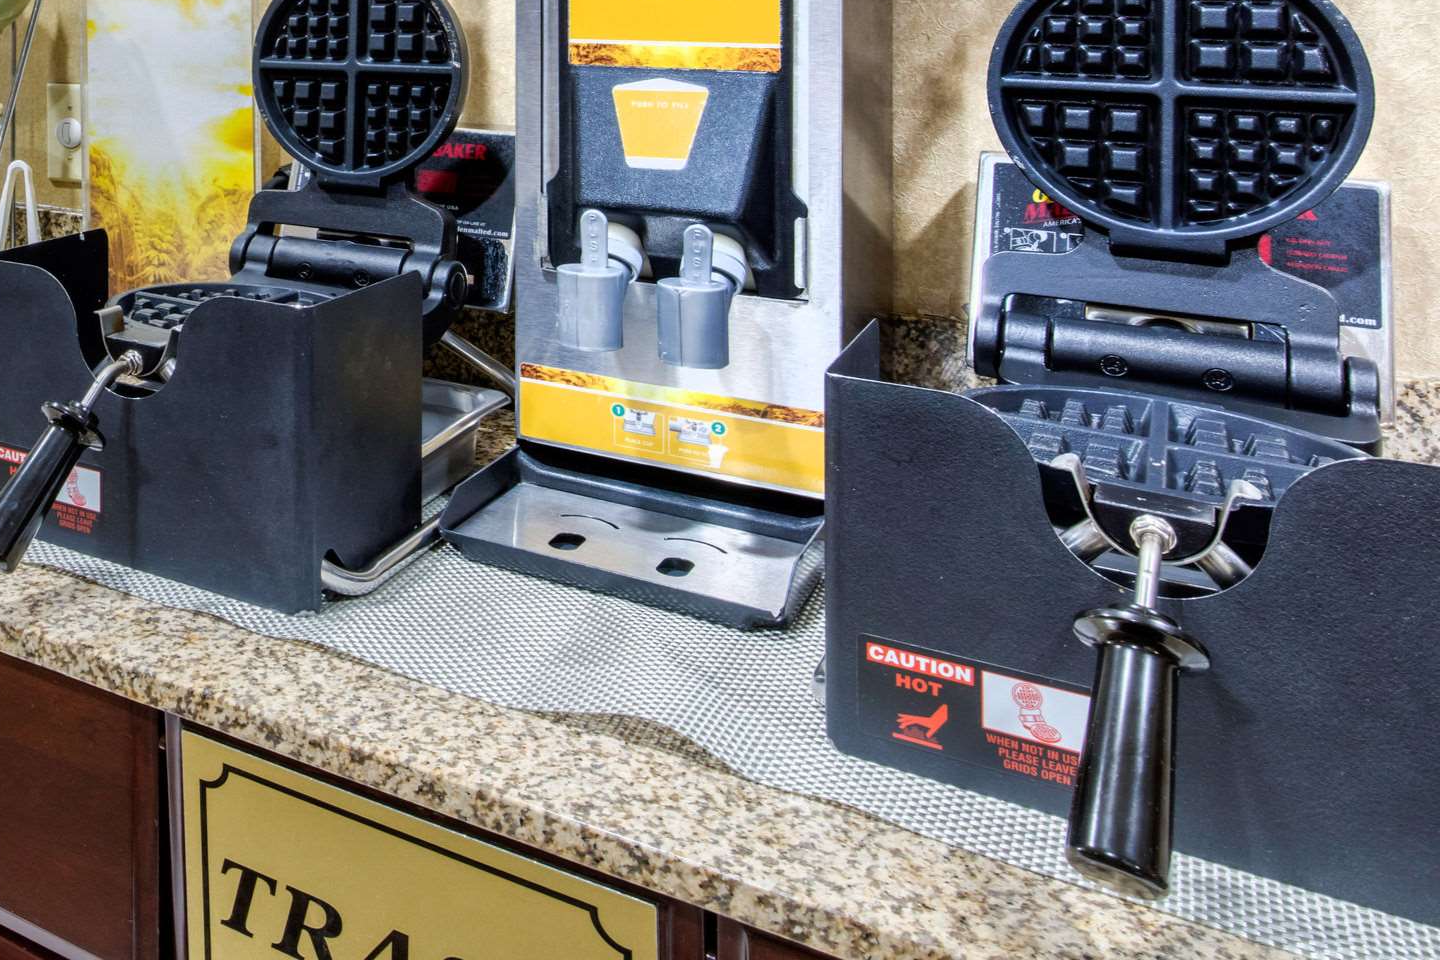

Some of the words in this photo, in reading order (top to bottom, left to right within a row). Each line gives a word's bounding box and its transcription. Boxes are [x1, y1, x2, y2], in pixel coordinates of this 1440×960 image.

[869, 645, 972, 682] CAUTION
[896, 673, 943, 697] HOT
[986, 732, 1018, 750] WHEN
[1022, 743, 1044, 756] NOT
[1047, 750, 1059, 760] IN
[1063, 753, 1080, 766] US
[997, 747, 1039, 766] PLEASE
[1042, 759, 1078, 776] LEAVE
[1003, 759, 1038, 776] GRIDS
[1041, 769, 1072, 785] OPEN
